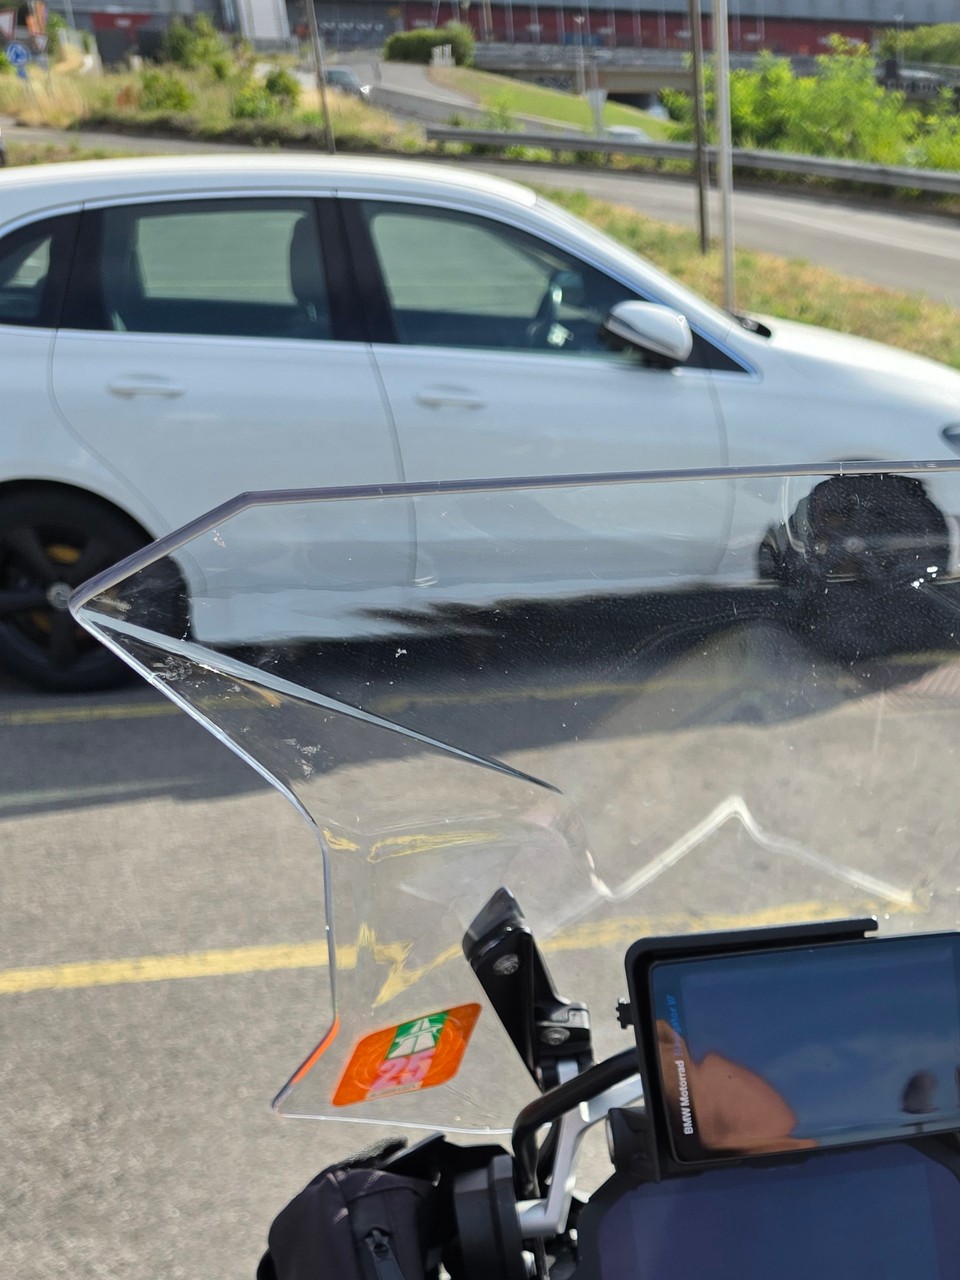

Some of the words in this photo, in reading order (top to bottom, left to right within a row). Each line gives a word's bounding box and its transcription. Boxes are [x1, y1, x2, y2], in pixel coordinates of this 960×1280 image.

[371, 1050, 436, 1091] 25
[675, 1059, 690, 1107] Motorrad
[680, 1106, 694, 1135] BMW
